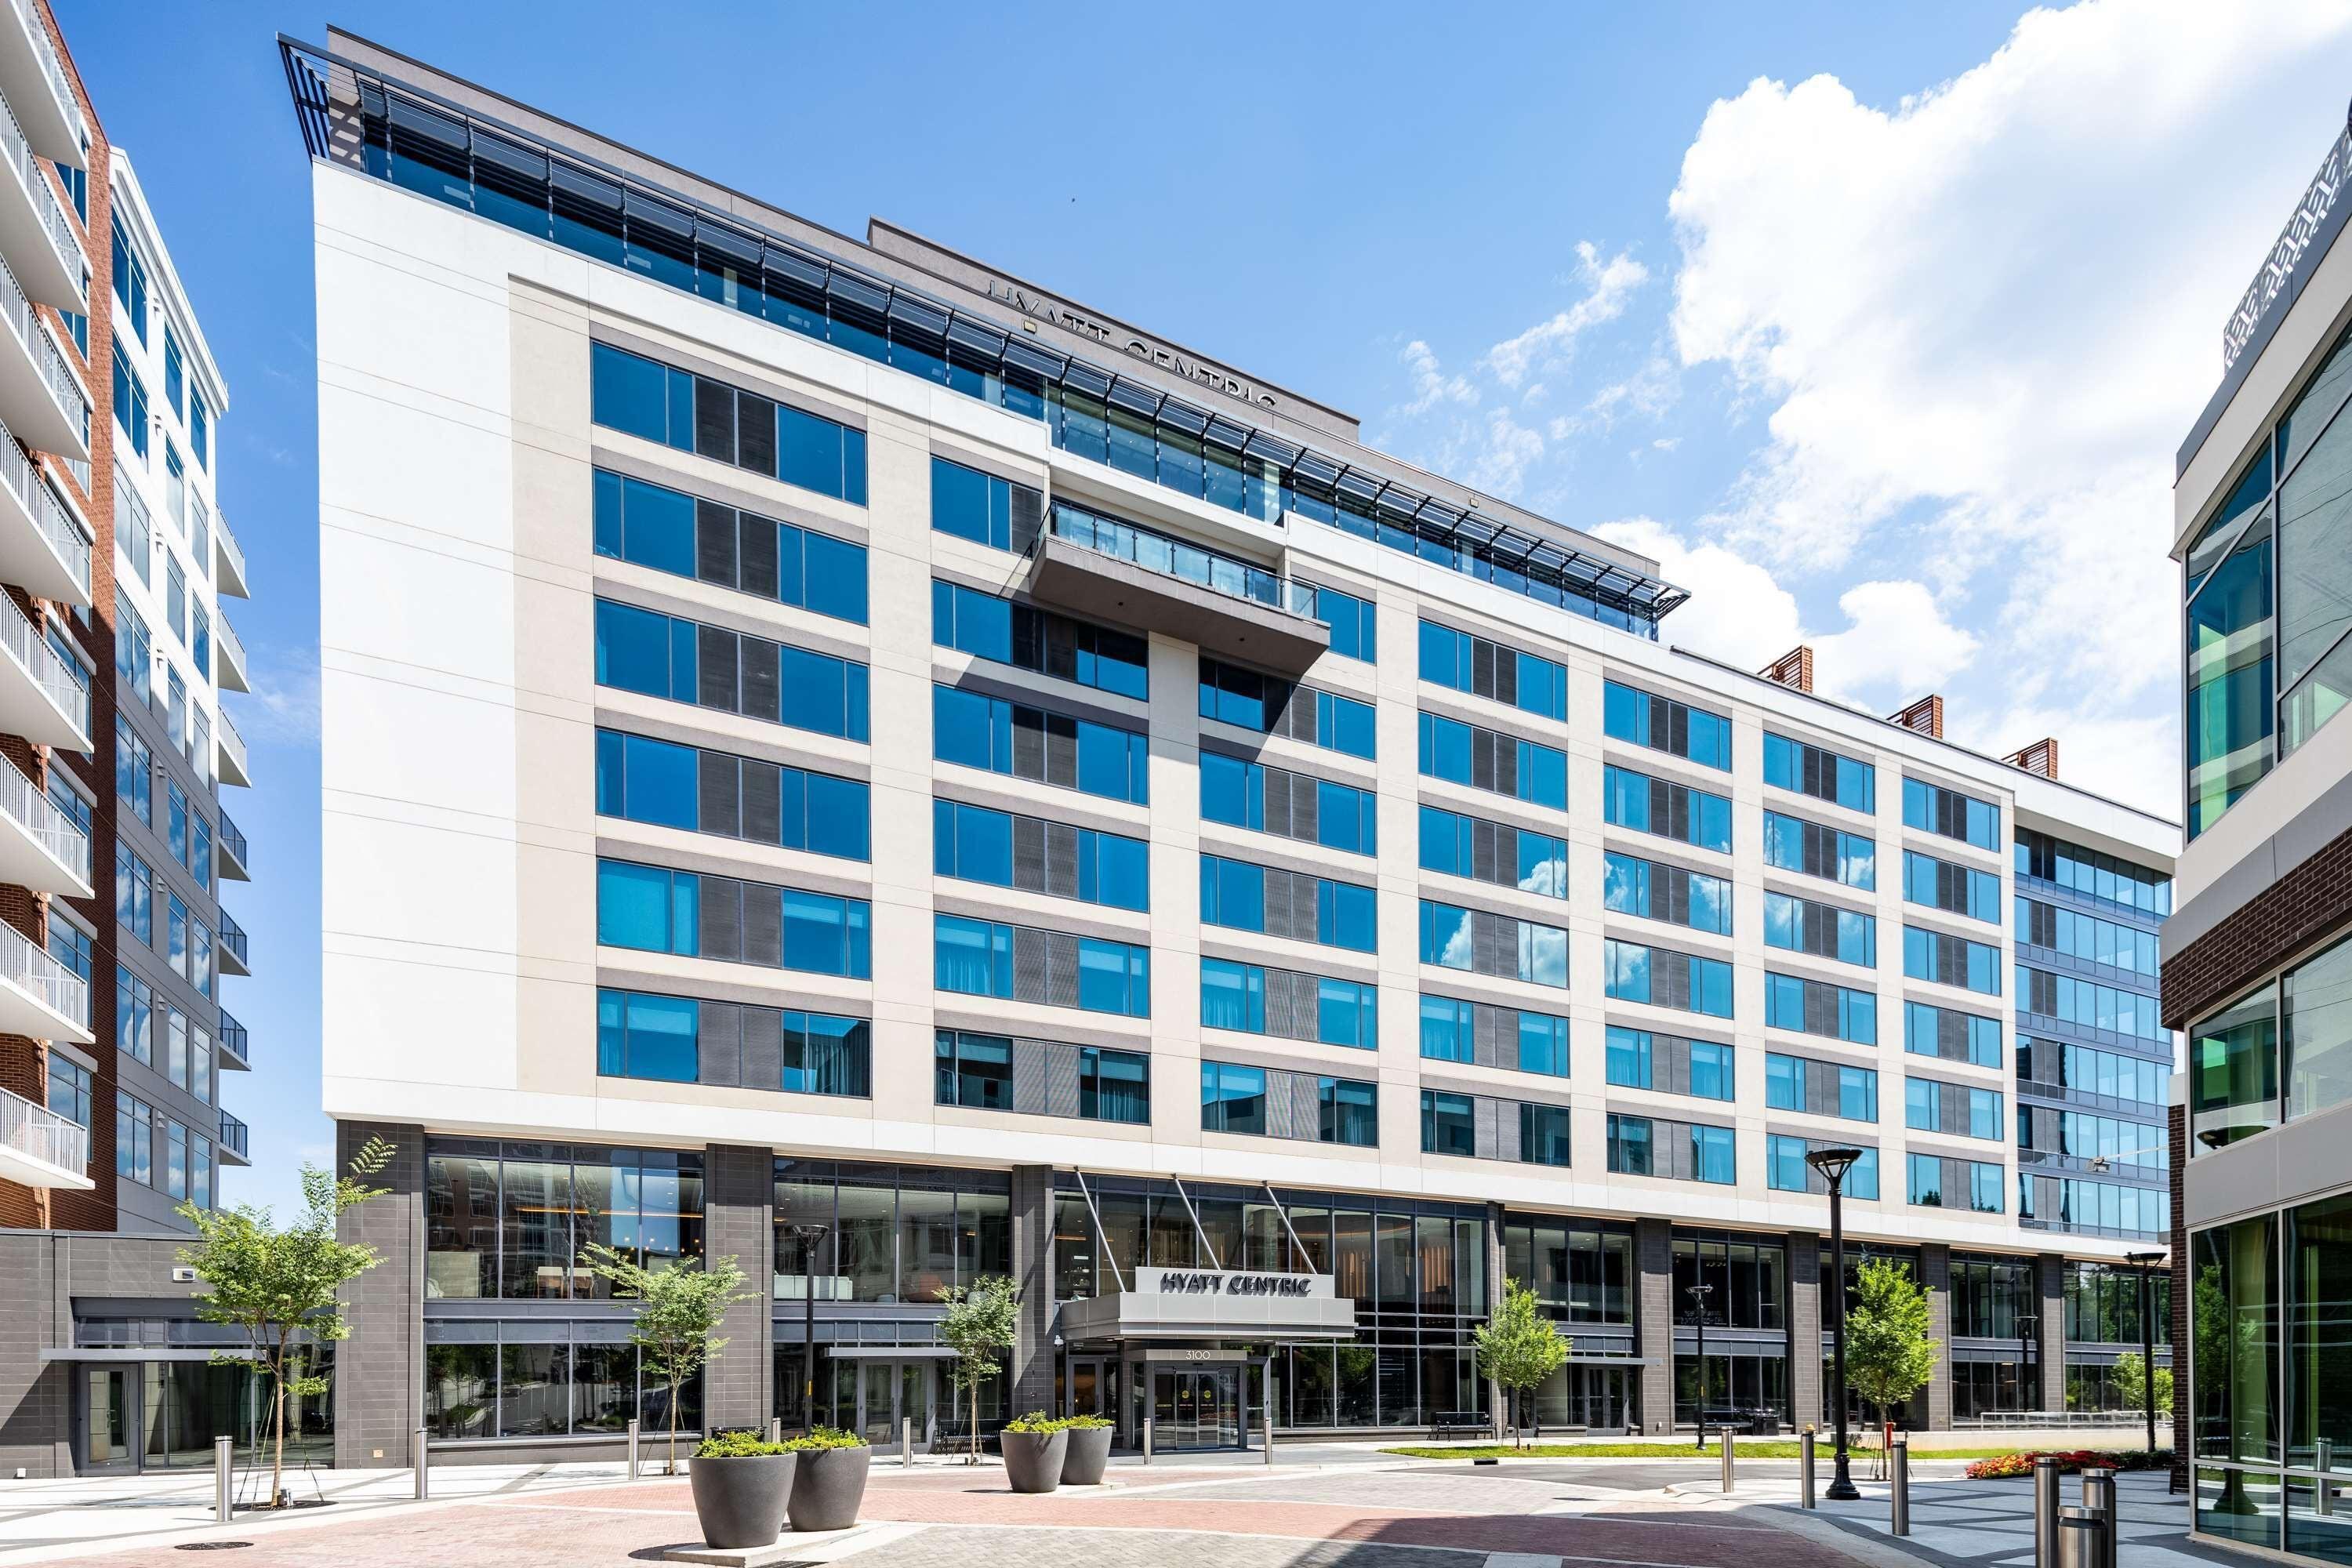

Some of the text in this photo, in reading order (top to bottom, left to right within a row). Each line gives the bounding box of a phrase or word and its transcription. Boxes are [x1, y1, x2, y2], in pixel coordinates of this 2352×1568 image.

[1163, 1272, 1312, 1294] HYATT CENTRIC
[1185, 1350, 1210, 1359] 3100
